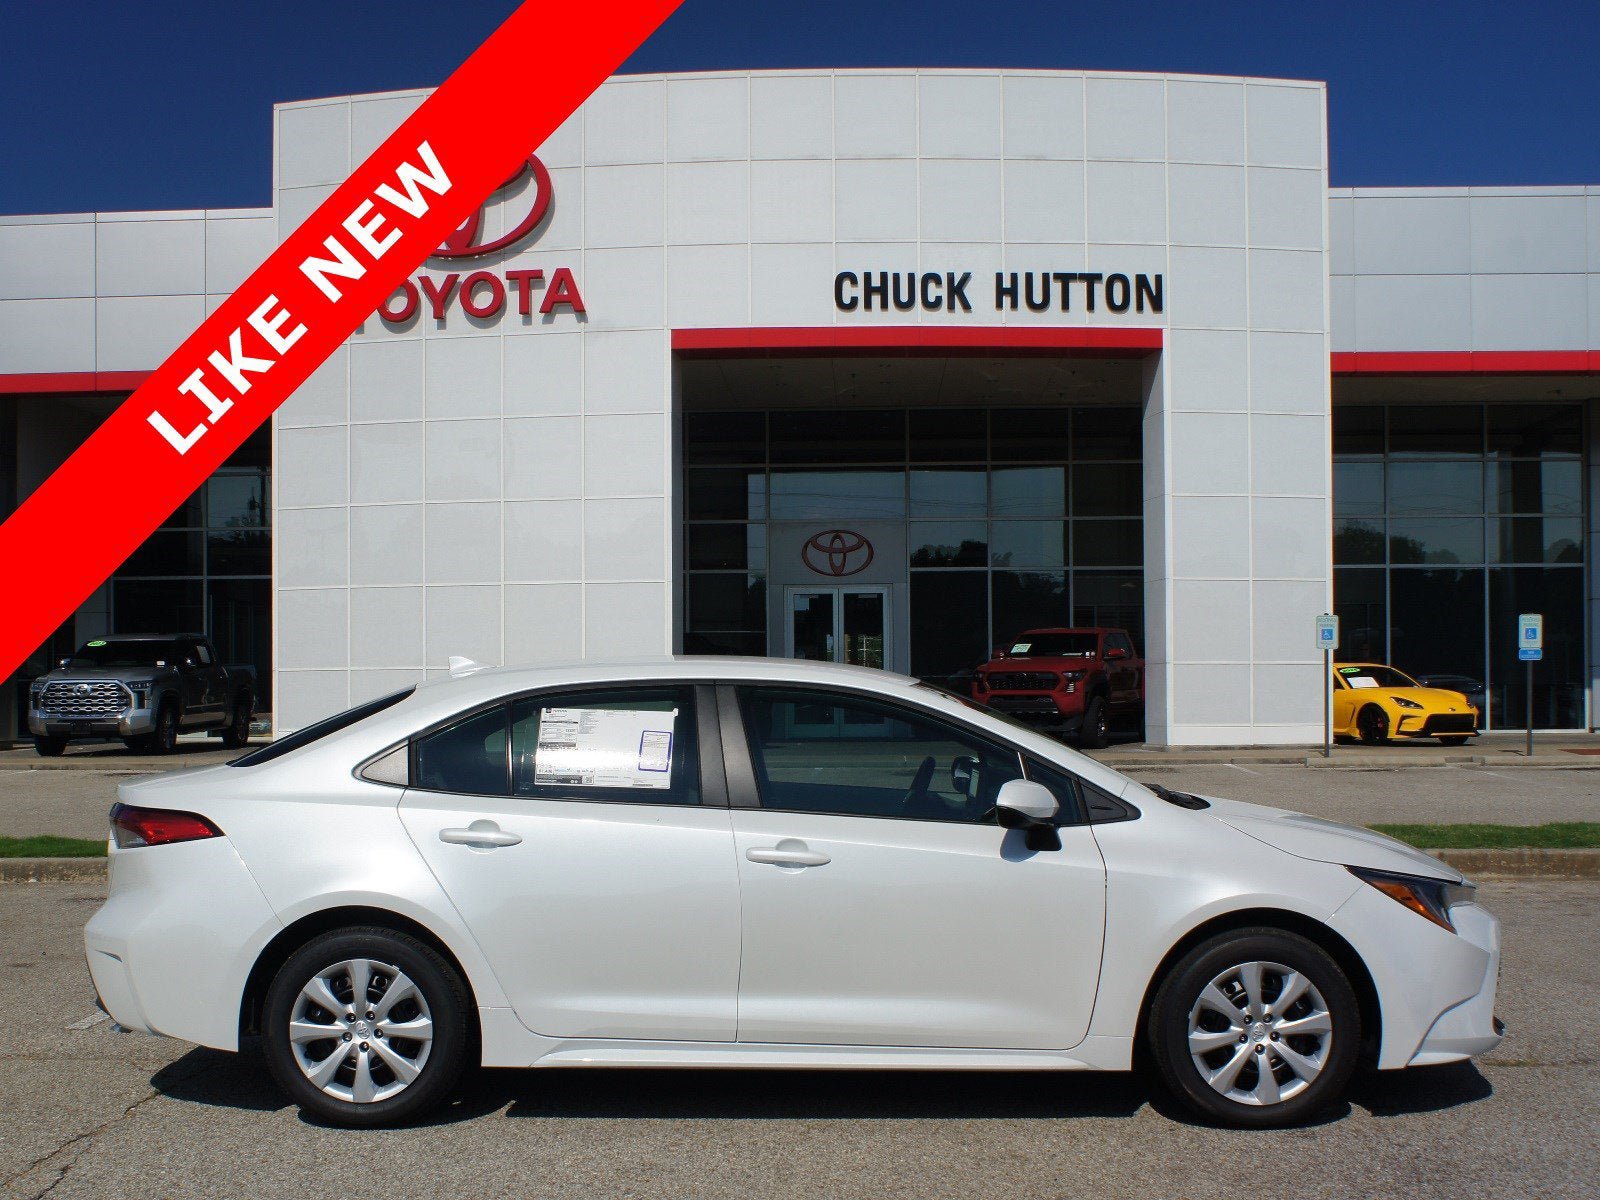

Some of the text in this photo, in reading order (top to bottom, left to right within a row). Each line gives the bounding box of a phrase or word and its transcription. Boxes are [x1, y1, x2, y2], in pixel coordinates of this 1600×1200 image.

[376, 267, 586, 322] OYOTA
[834, 271, 1163, 313] CHUCK HUTTON
